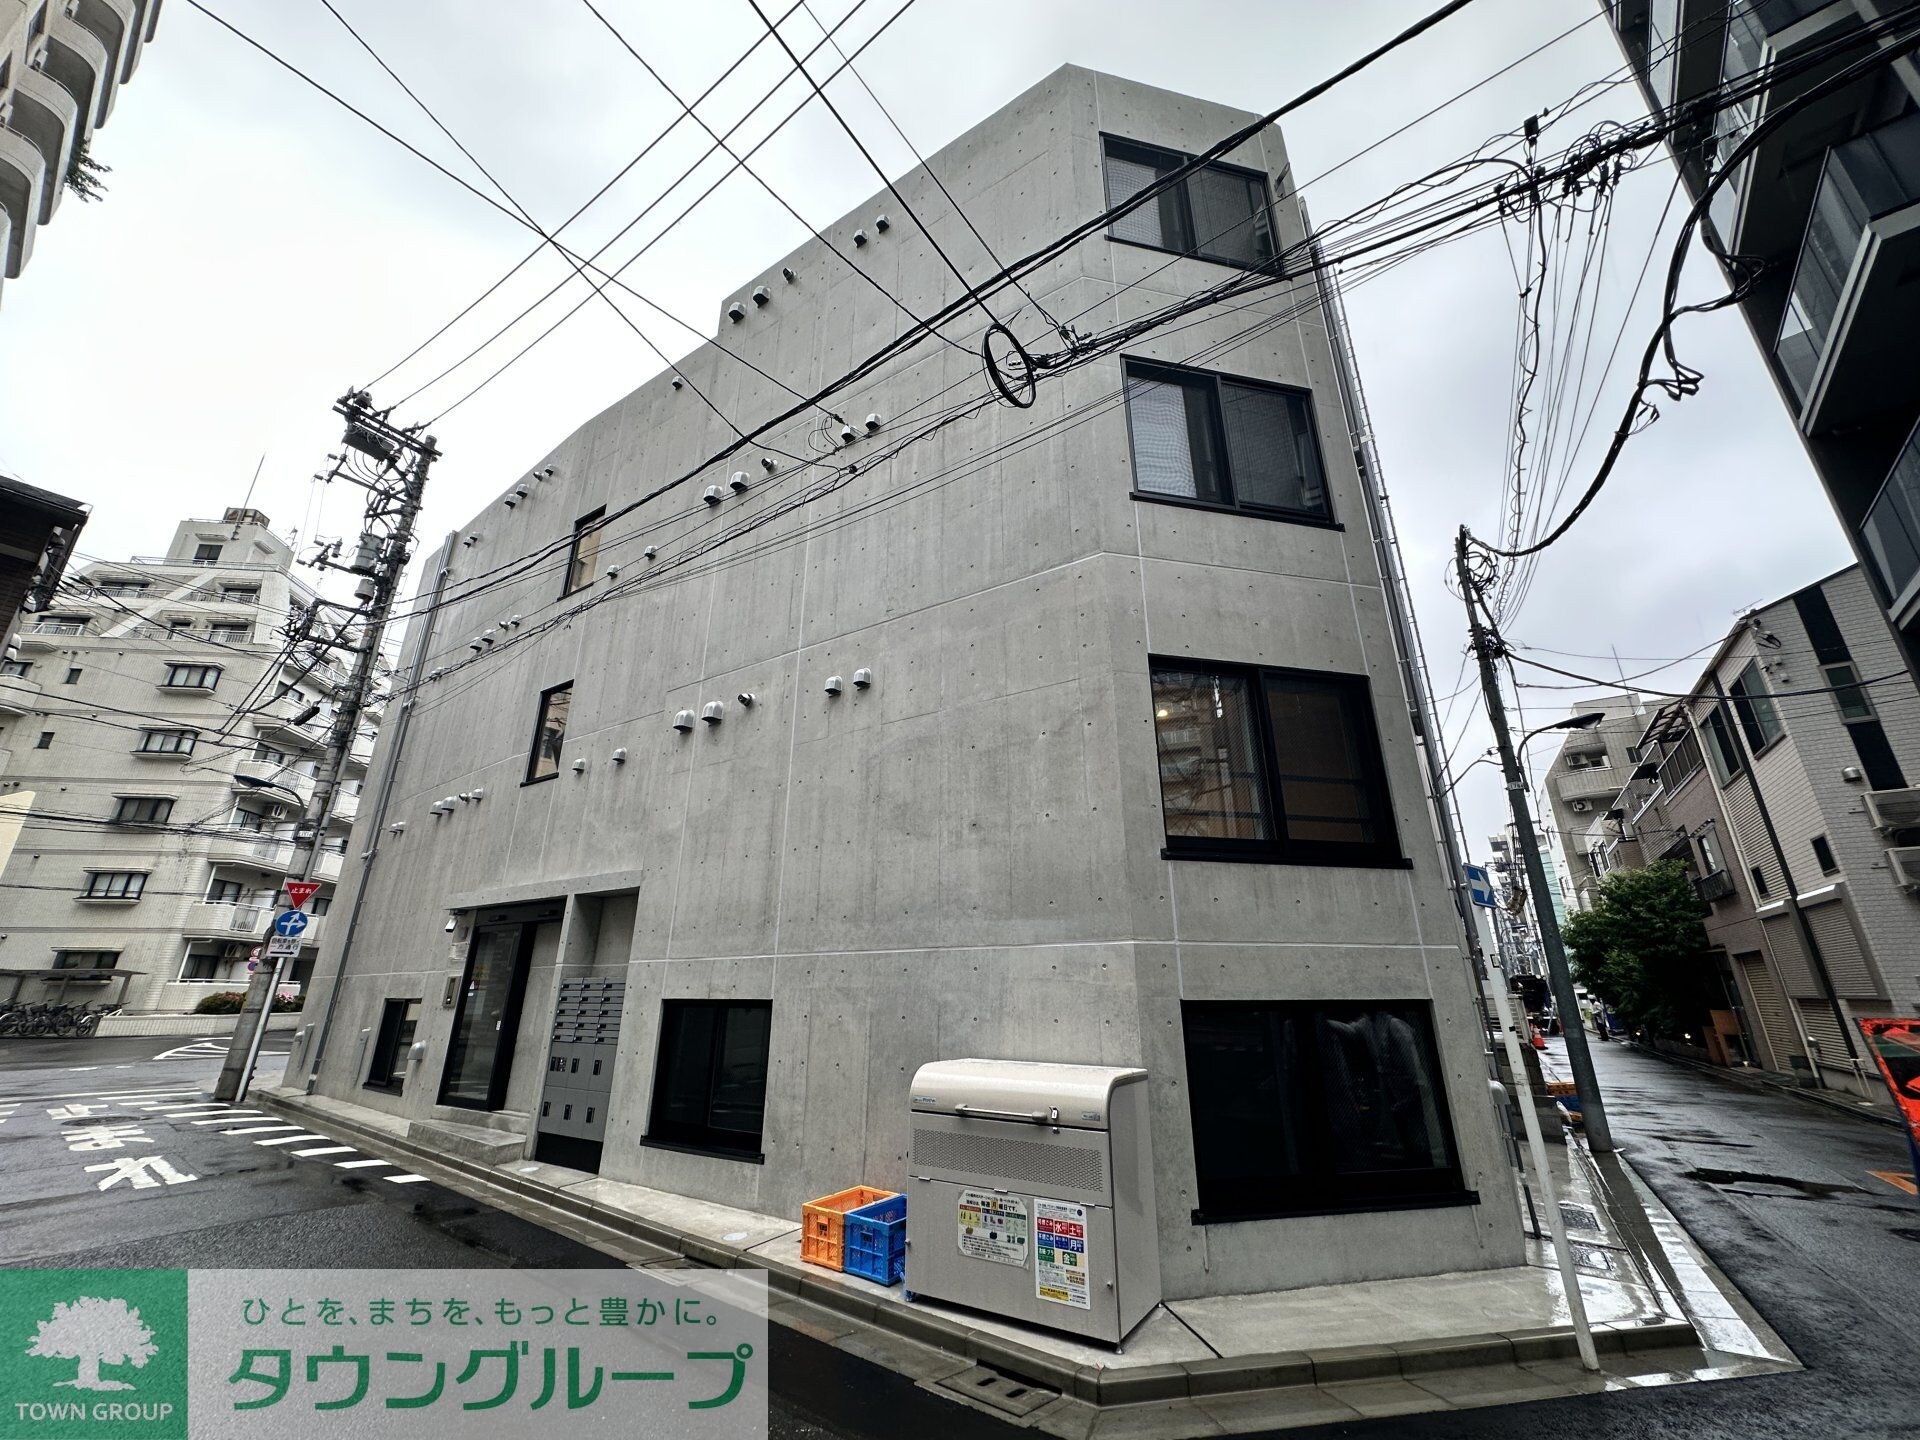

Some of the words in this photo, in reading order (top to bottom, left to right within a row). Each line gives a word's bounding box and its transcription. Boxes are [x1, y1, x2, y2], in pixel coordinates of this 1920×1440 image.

[46, 1103, 198, 1191] 止まれ
[1055, 1222, 1063, 1232] 水
[1069, 1225, 1077, 1236] 土
[1070, 1239, 1077, 1251] 月
[1063, 1253, 1071, 1264] 金
